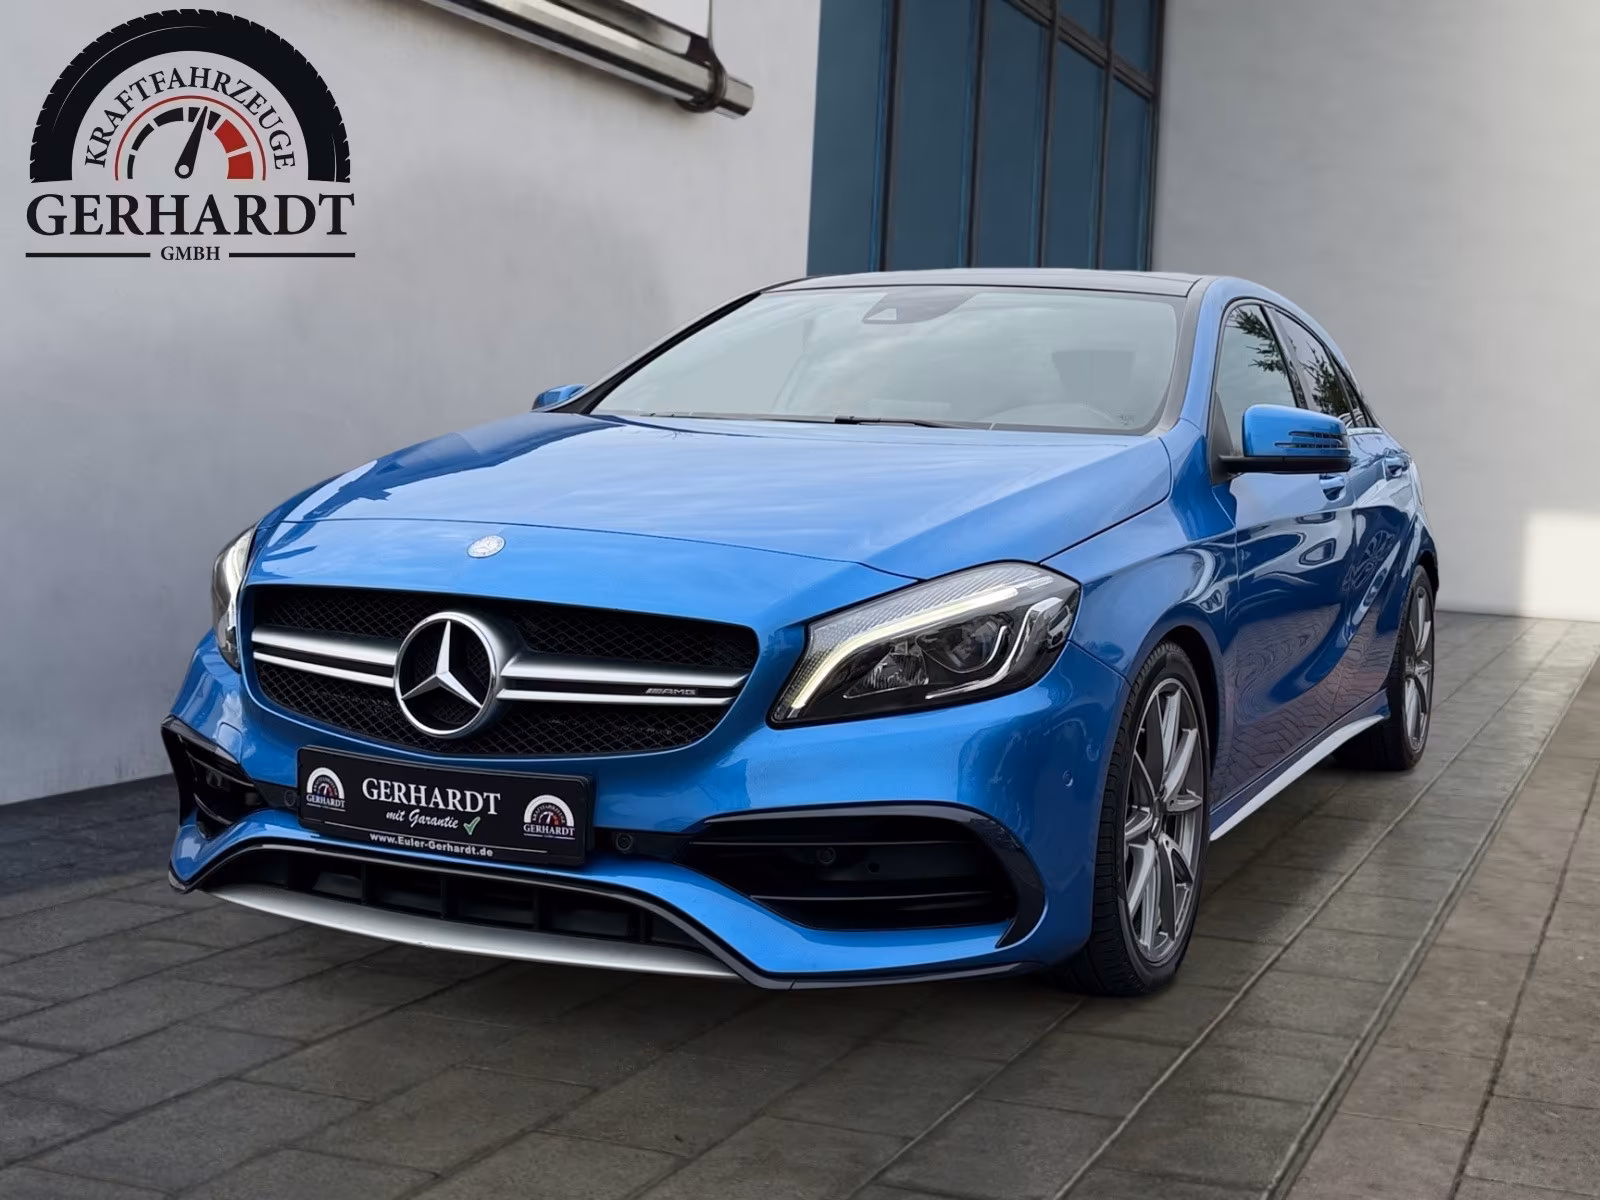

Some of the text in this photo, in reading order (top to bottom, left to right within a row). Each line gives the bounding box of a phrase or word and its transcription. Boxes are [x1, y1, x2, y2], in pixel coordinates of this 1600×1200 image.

[306, 793, 346, 808] GERHARDT
[362, 777, 500, 815] GERHARDT
[386, 808, 459, 829] mit Garantie
[523, 823, 576, 836] GERHARDT
[369, 832, 494, 857] www.Euler-Gerhardt.de
